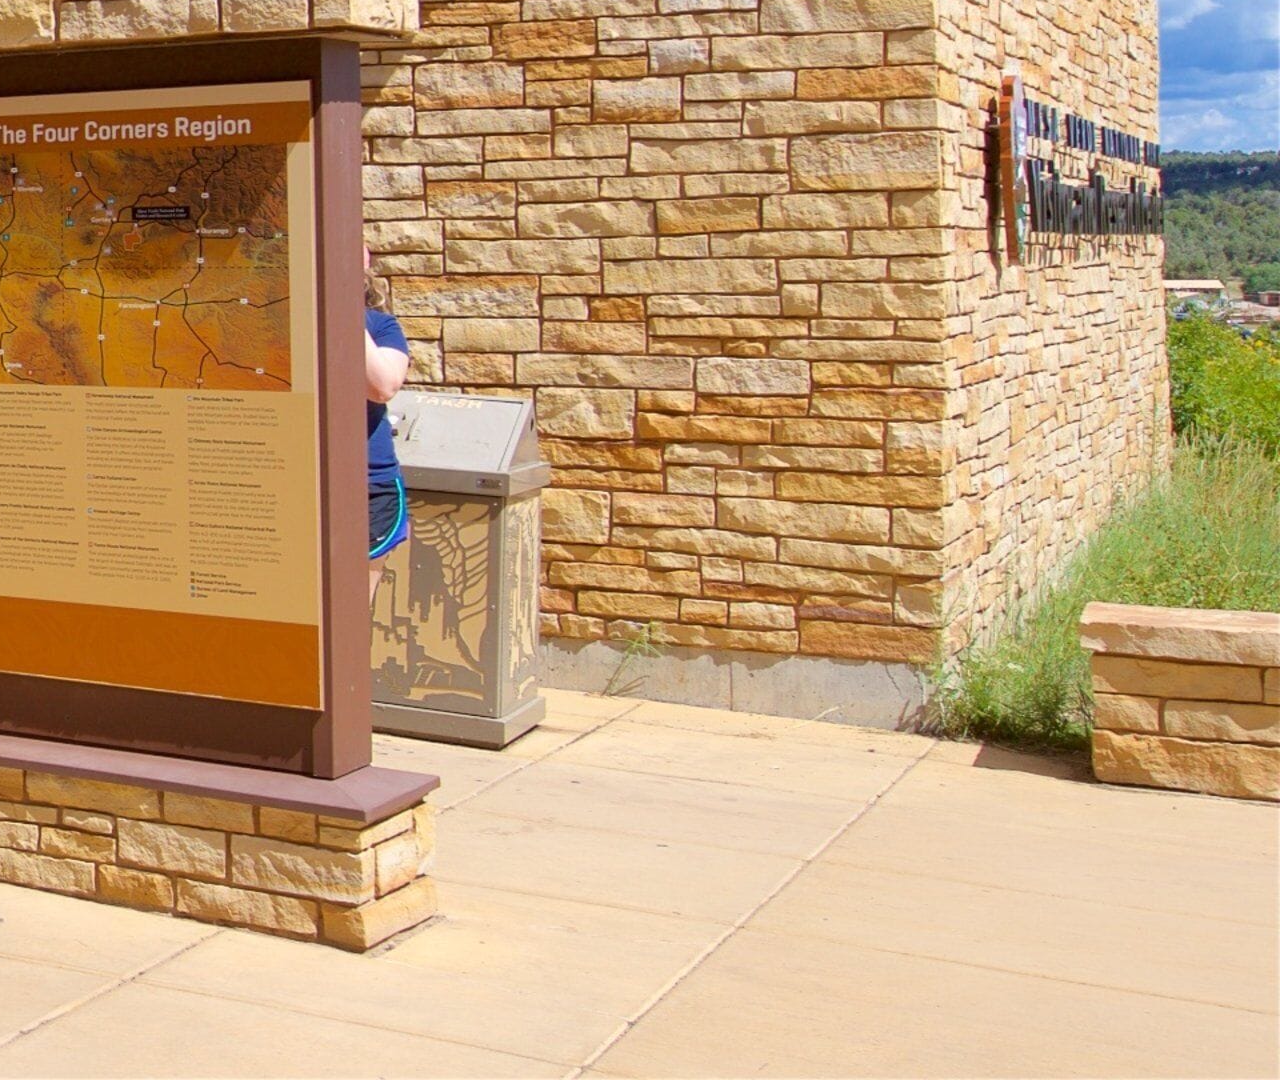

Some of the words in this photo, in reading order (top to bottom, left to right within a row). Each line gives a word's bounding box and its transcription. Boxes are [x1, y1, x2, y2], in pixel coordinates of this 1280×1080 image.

[32, 121, 79, 143] Four
[84, 119, 169, 141] Corners
[175, 115, 252, 141] Region
